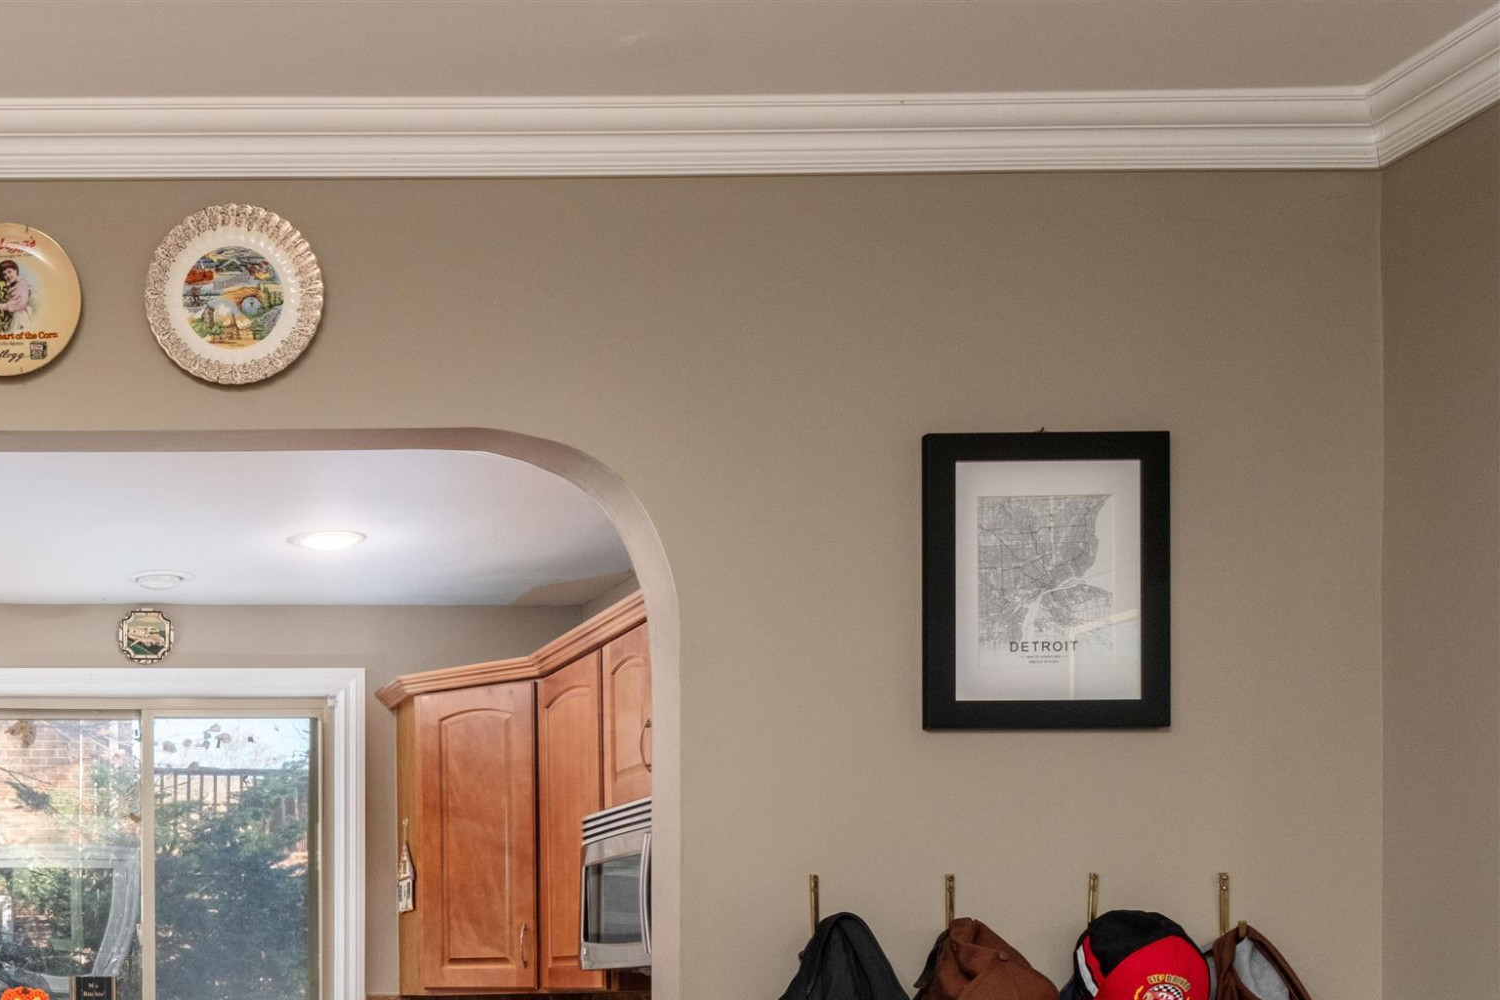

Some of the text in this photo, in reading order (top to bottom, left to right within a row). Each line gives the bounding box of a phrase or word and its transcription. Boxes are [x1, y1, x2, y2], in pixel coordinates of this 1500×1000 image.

[15, 332, 25, 340] of
[25, 332, 38, 340] the
[38, 331, 58, 339] Corn
[1009, 640, 1078, 653] DETROIT
